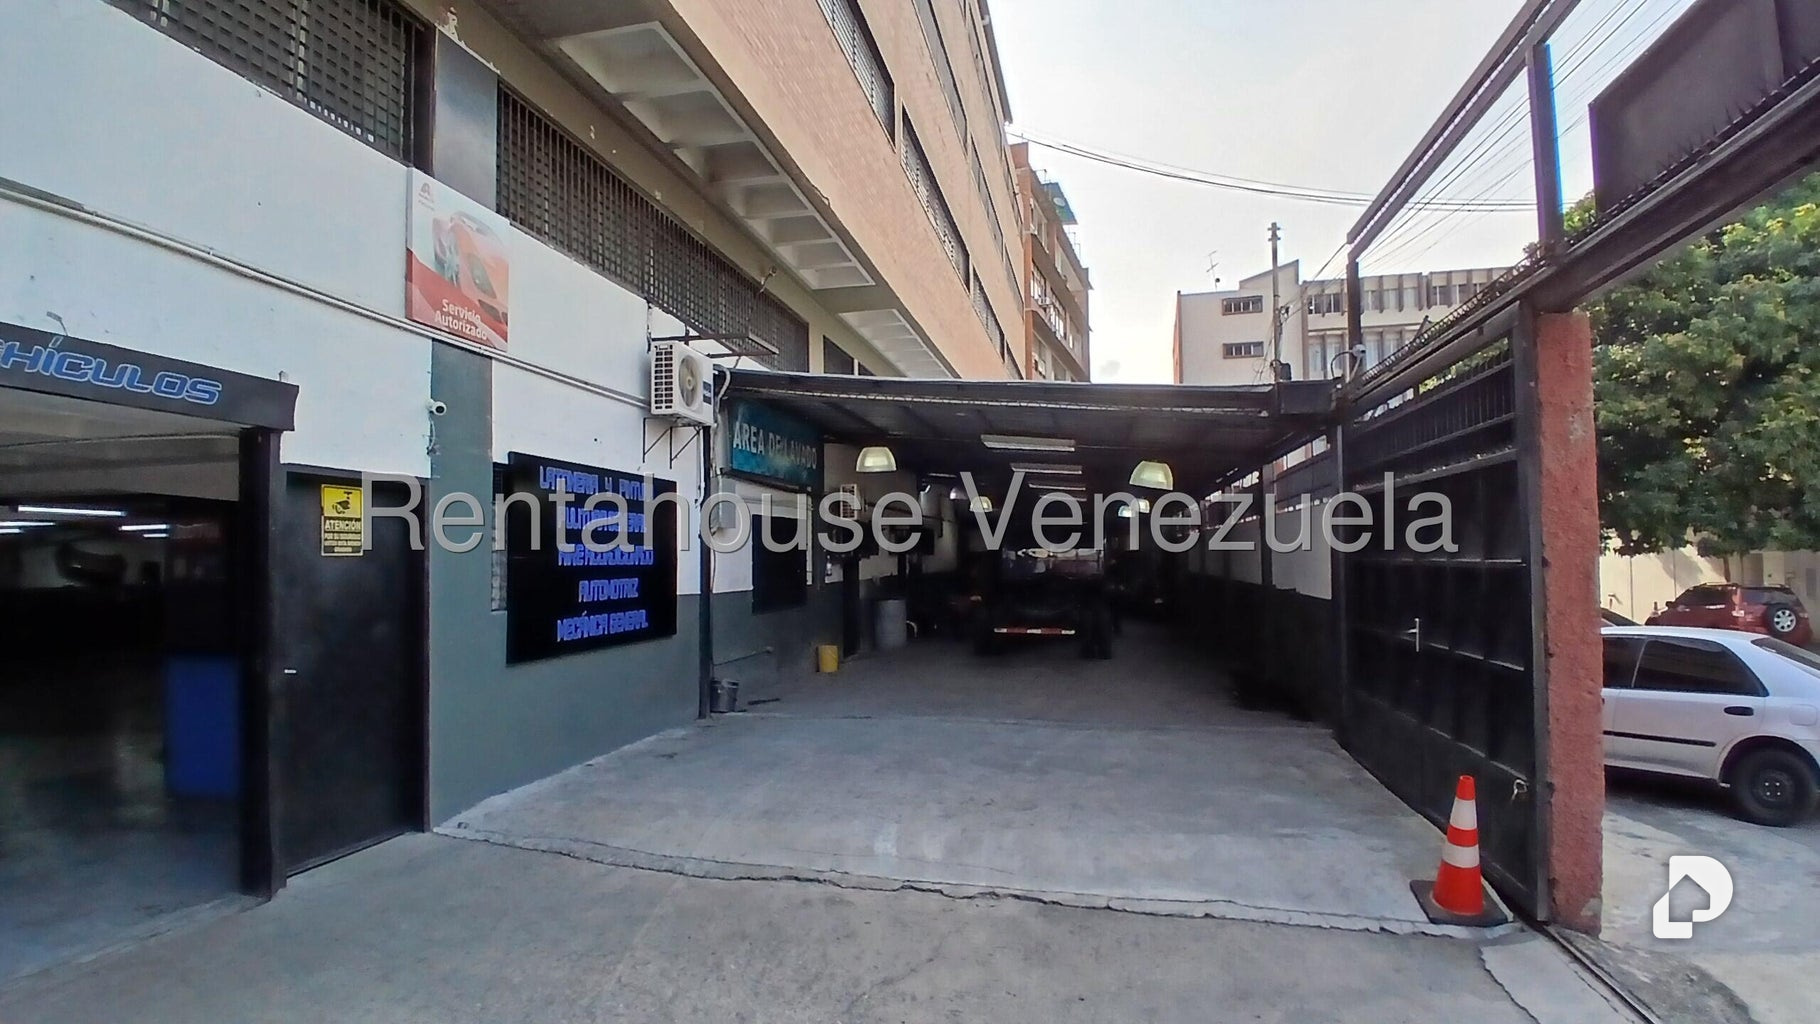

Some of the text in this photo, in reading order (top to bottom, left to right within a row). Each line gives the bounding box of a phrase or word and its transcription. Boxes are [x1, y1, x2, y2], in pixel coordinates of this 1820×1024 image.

[442, 298, 481, 322] Servicio
[434, 310, 488, 340] Autorizado
[0, 337, 222, 405] HÍCULOS
[325, 519, 361, 532] ATENCIÓN
[578, 578, 639, 602] AUTOMOTRIZ
[557, 610, 648, 642] MECÁNICA GENERAL
